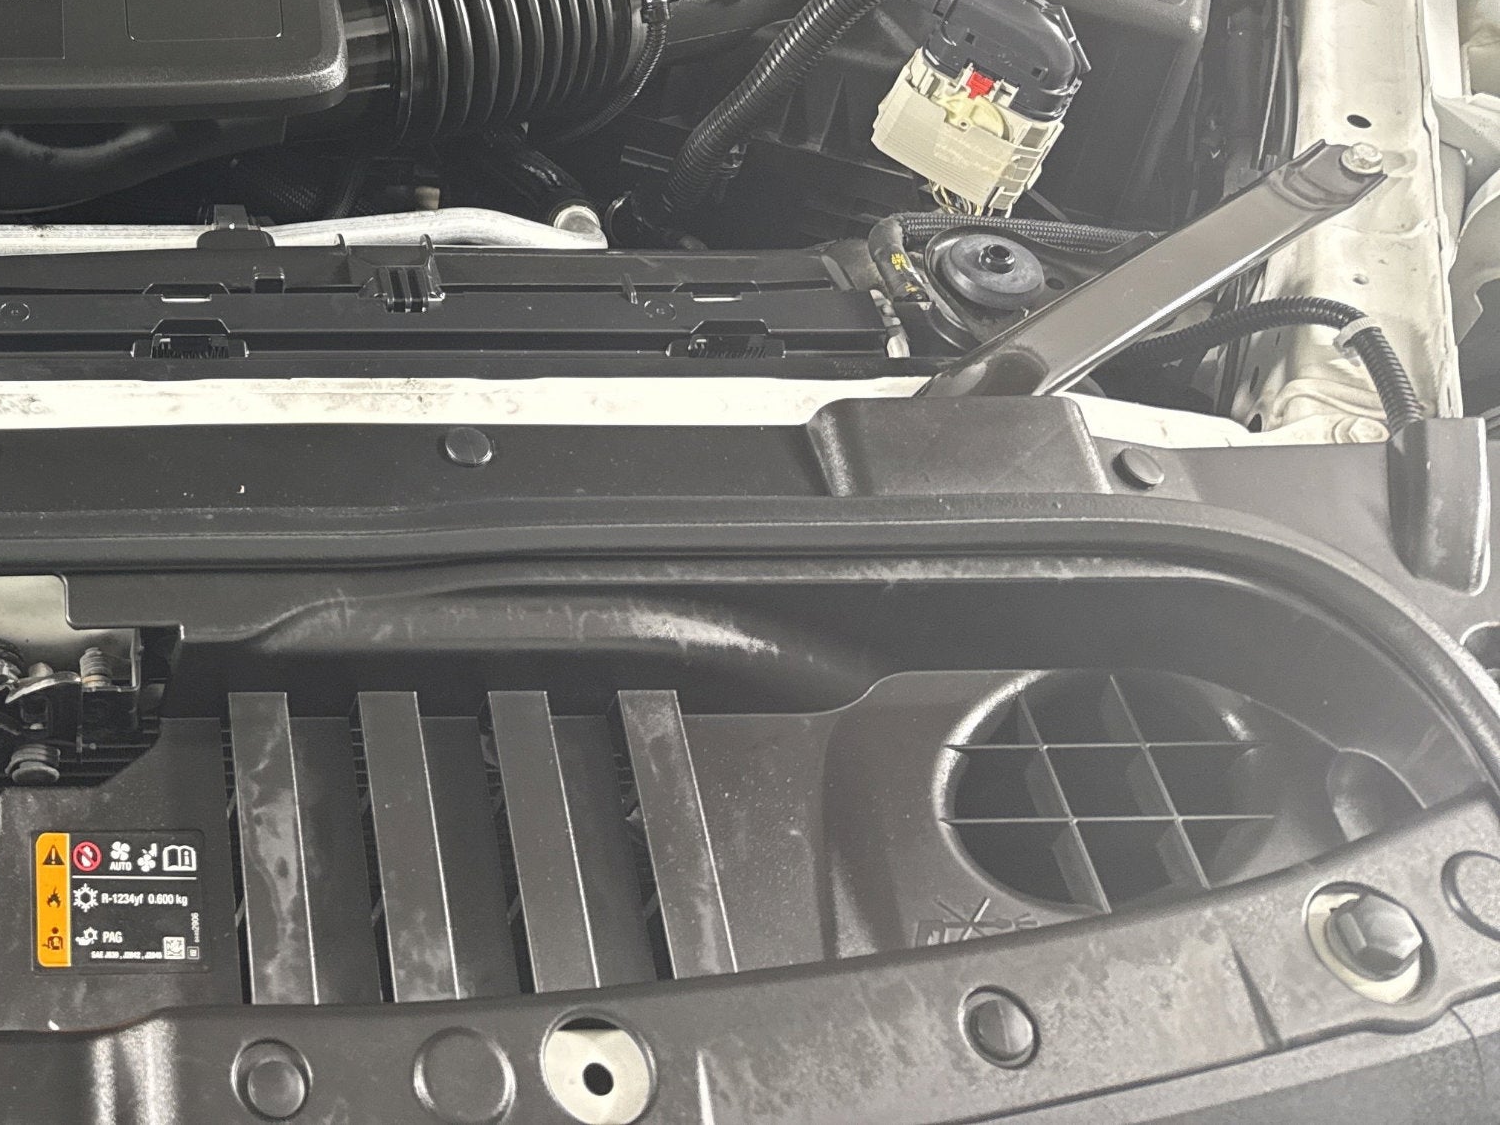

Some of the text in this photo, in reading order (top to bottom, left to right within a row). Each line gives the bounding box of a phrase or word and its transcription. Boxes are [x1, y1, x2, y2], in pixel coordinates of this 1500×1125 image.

[109, 861, 132, 871] AUTO
[101, 893, 188, 907] R-1234yf 0.600 kg
[102, 931, 123, 943] PAG
